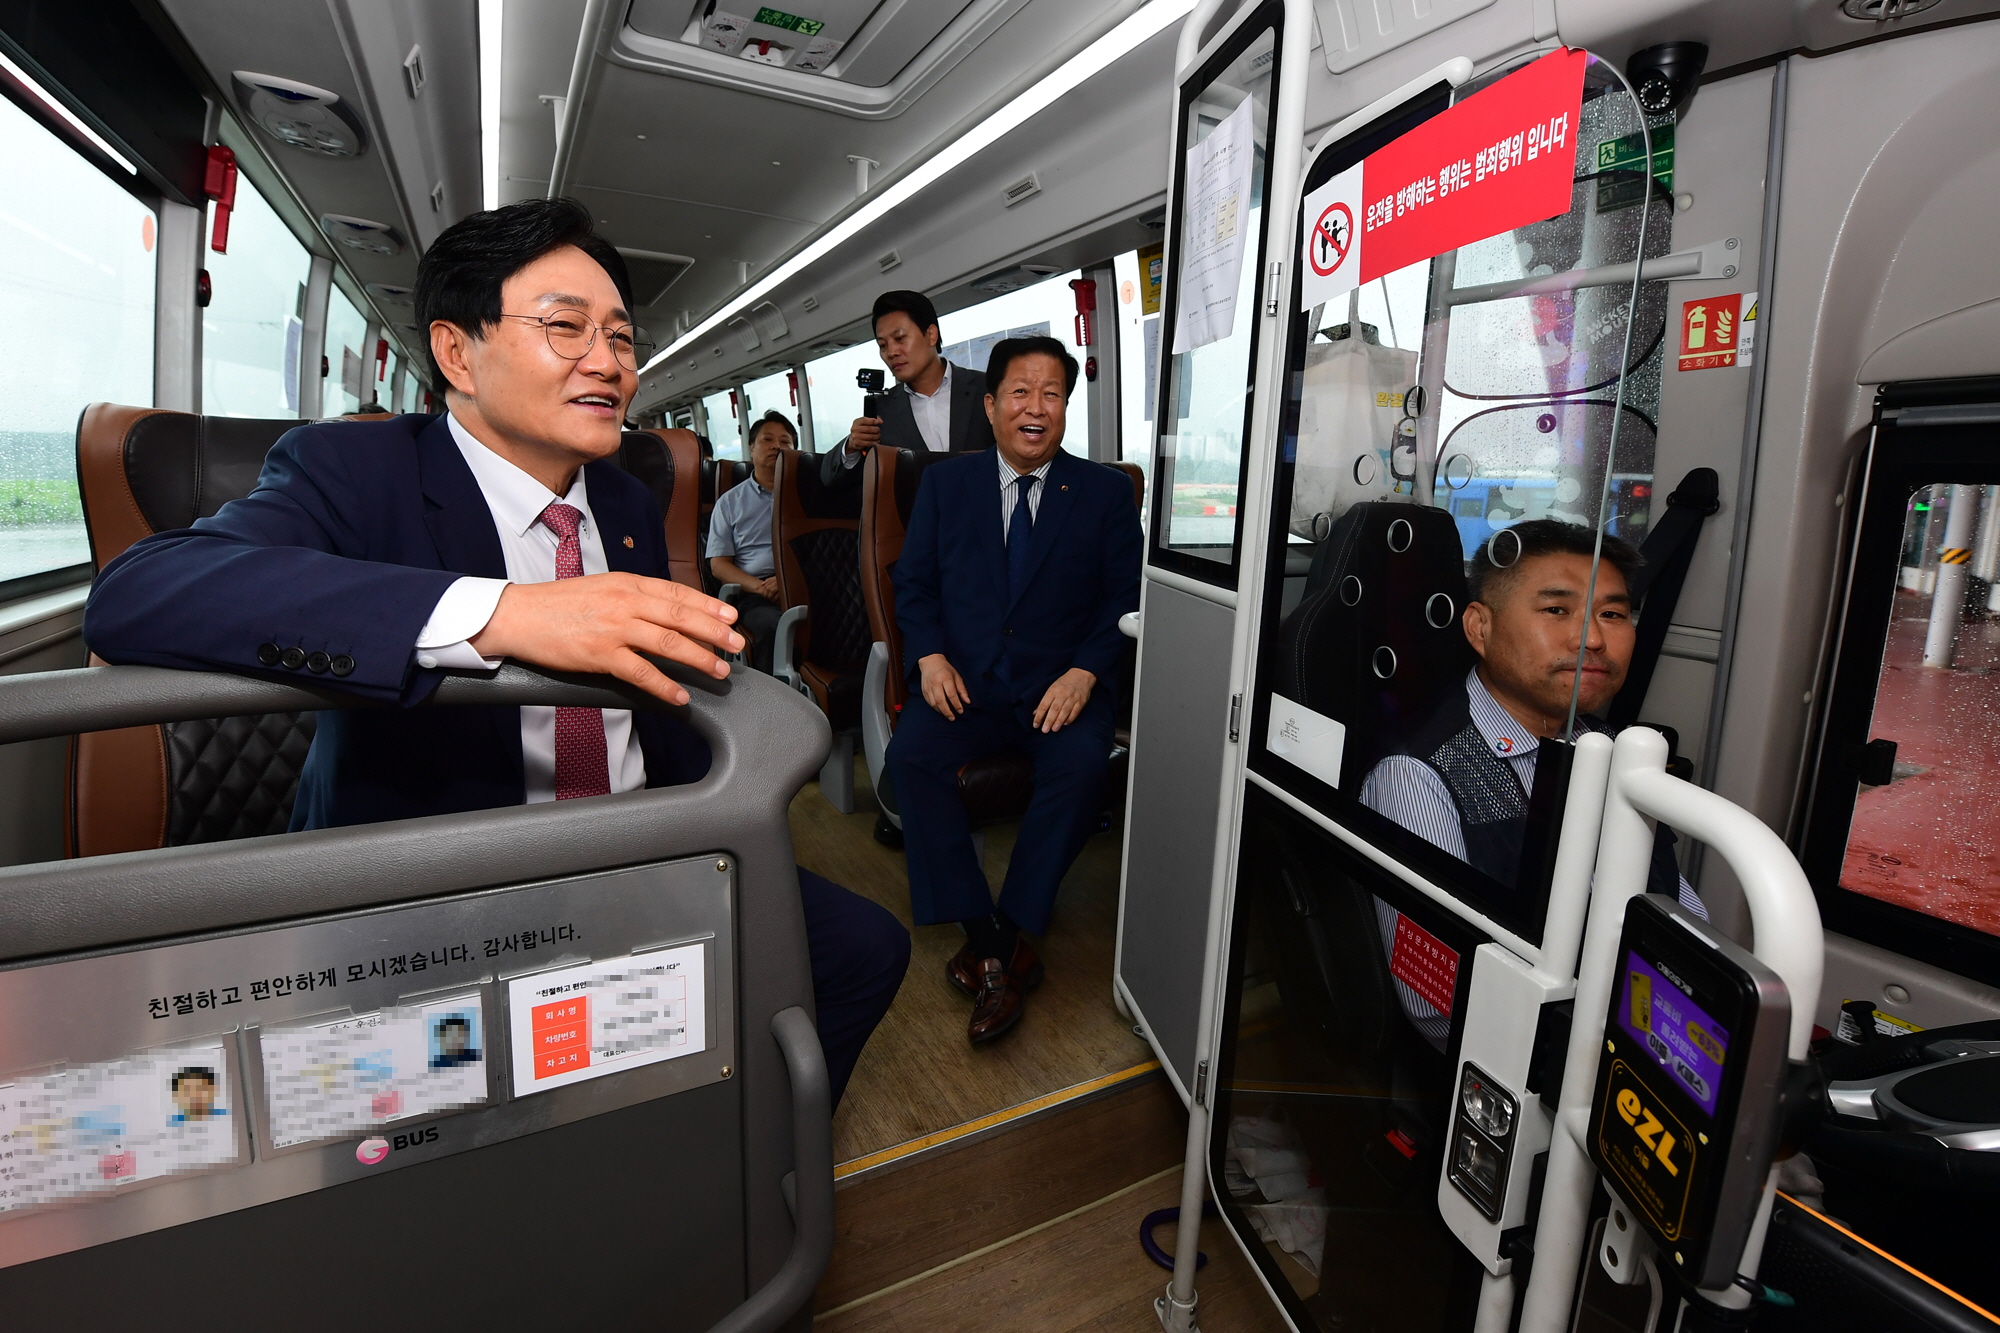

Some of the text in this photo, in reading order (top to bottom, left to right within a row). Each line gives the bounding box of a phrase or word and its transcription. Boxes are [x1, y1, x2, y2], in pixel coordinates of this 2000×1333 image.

[1366, 111, 1568, 233] 운전을 방해하는 행위는 범죄행위 입니다
[148, 923, 582, 1019] 친절하고 편안하게 모시겠습니다. 감사합니다.
[545, 1030, 577, 1044] 차량번호
[393, 1126, 439, 1151] BUS
